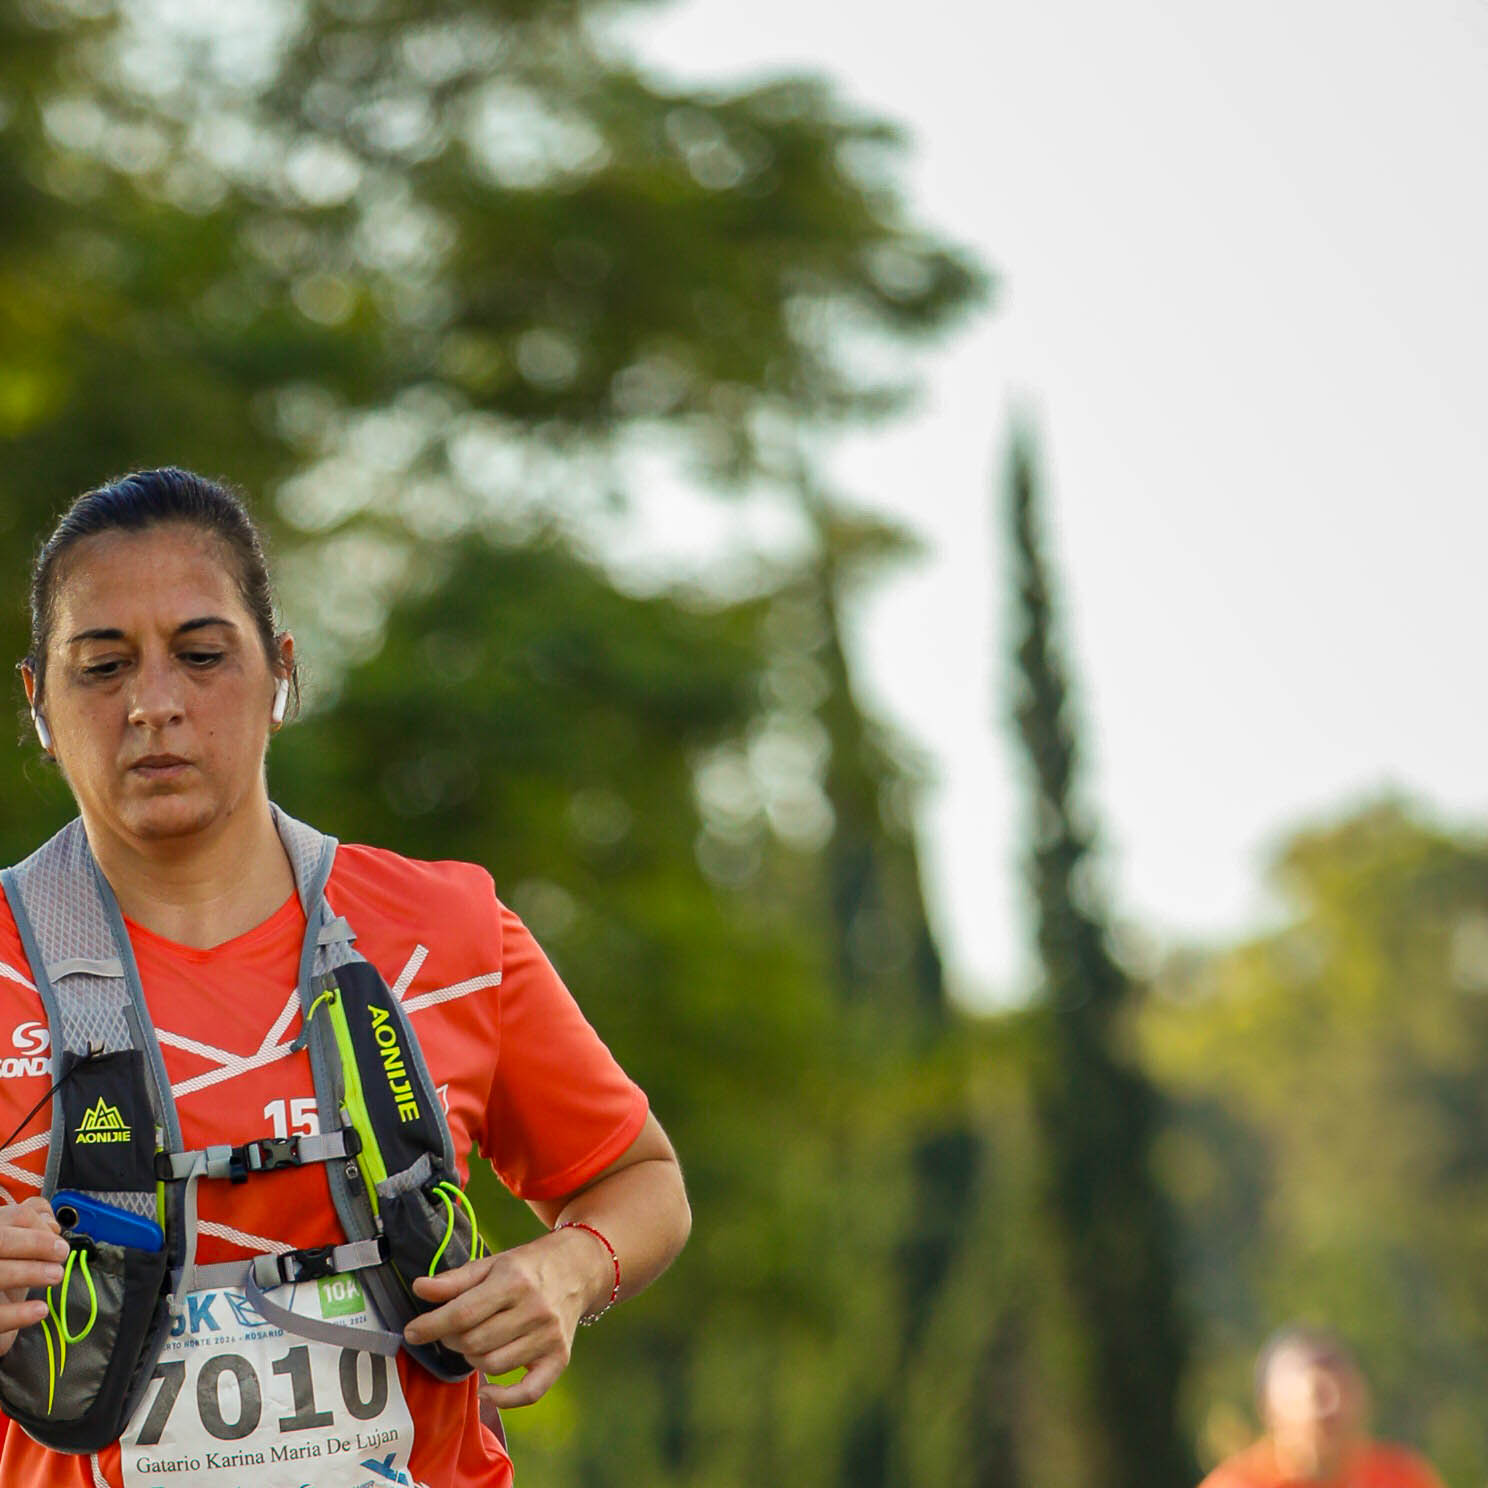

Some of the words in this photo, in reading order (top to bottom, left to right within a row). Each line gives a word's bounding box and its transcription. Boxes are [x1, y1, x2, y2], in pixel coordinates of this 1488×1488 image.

[367, 1004, 420, 1123] AONIJIE
[75, 1130, 131, 1144] AONIJIE
[323, 1279, 360, 1303] 10K
[184, 1338, 210, 1348] NORTE
[245, 1330, 284, 1341] ROSARIO
[136, 1345, 388, 1446] 7010
[136, 1456, 201, 1474] Gatario
[206, 1451, 266, 1470] Karina
[270, 1441, 322, 1463] Maria
[327, 1437, 351, 1455] De
[356, 1428, 399, 1450] Lujan
